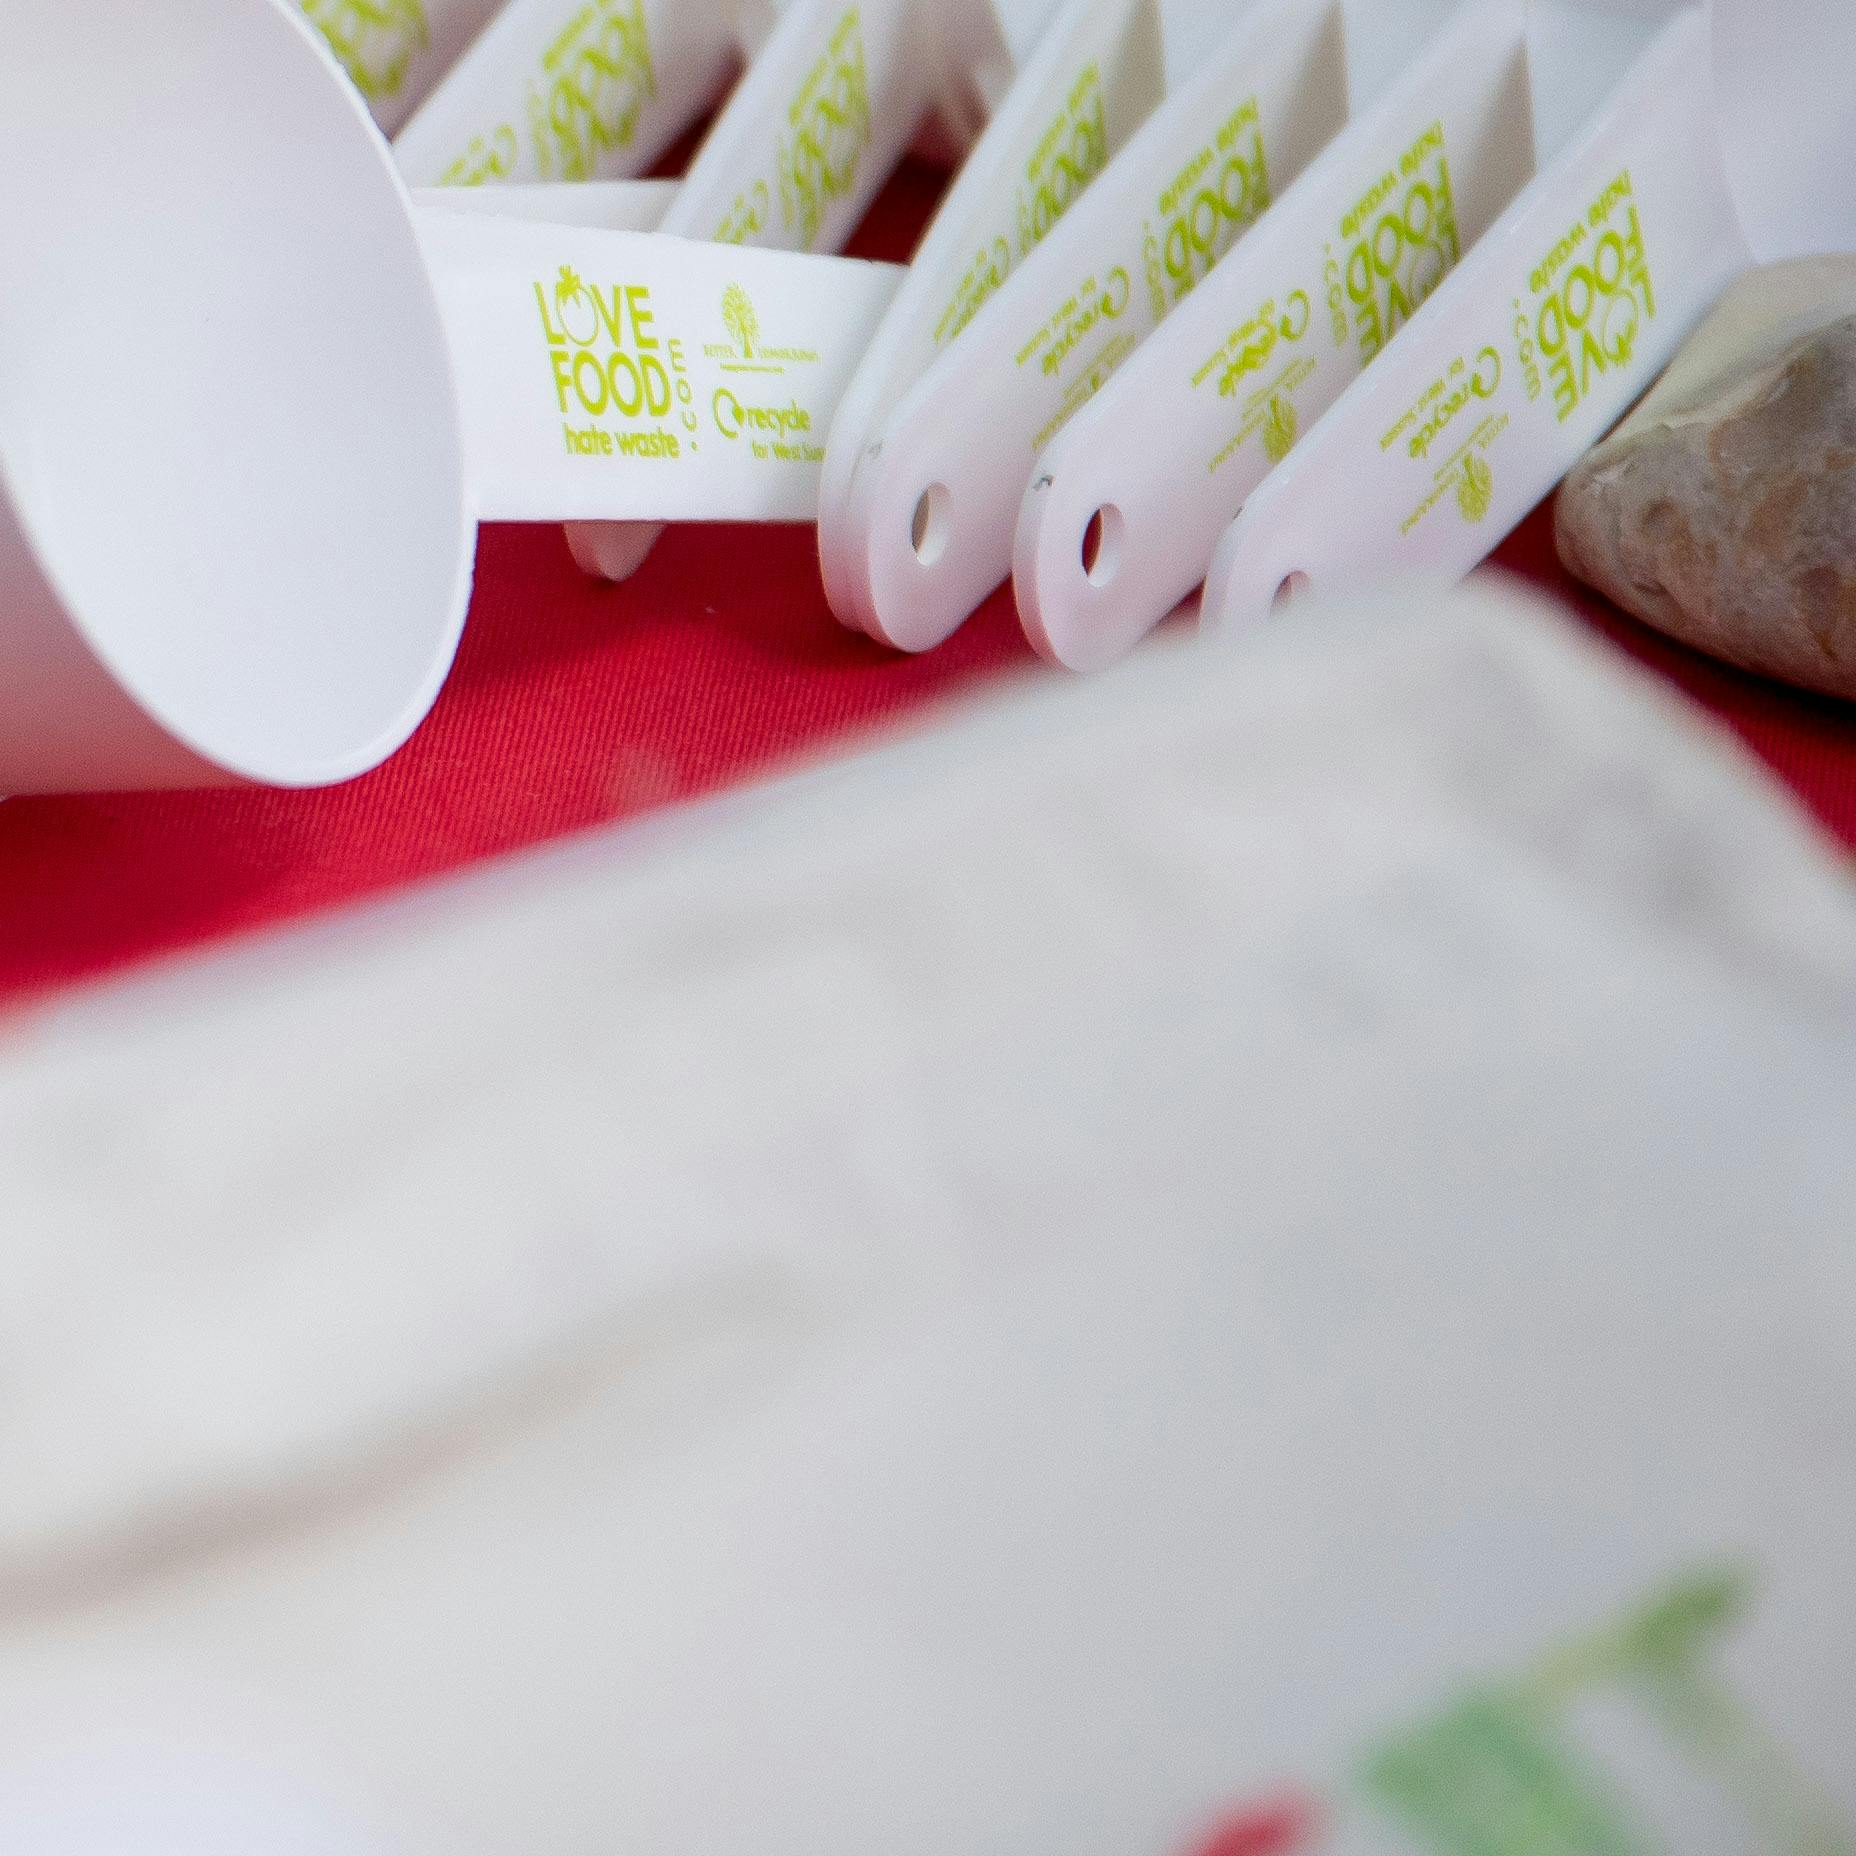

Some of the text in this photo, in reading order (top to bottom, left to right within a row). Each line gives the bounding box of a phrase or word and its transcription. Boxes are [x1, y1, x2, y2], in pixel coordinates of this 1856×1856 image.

[1159, 96, 1259, 217] hate waste
[1165, 131, 1271, 279] FOOD
[1341, 120, 1444, 239] hate waste
[1346, 156, 1456, 304] FOOD
[1529, 167, 1632, 295] hate waste
[1538, 205, 1646, 357] FOOD
[532, 263, 660, 349] LOVE
[1549, 262, 1656, 424] LOVE
[550, 350, 672, 417] FOOD
[562, 422, 681, 459] hate waste
[748, 399, 812, 439] recycle
[1409, 381, 1471, 459] recycle
